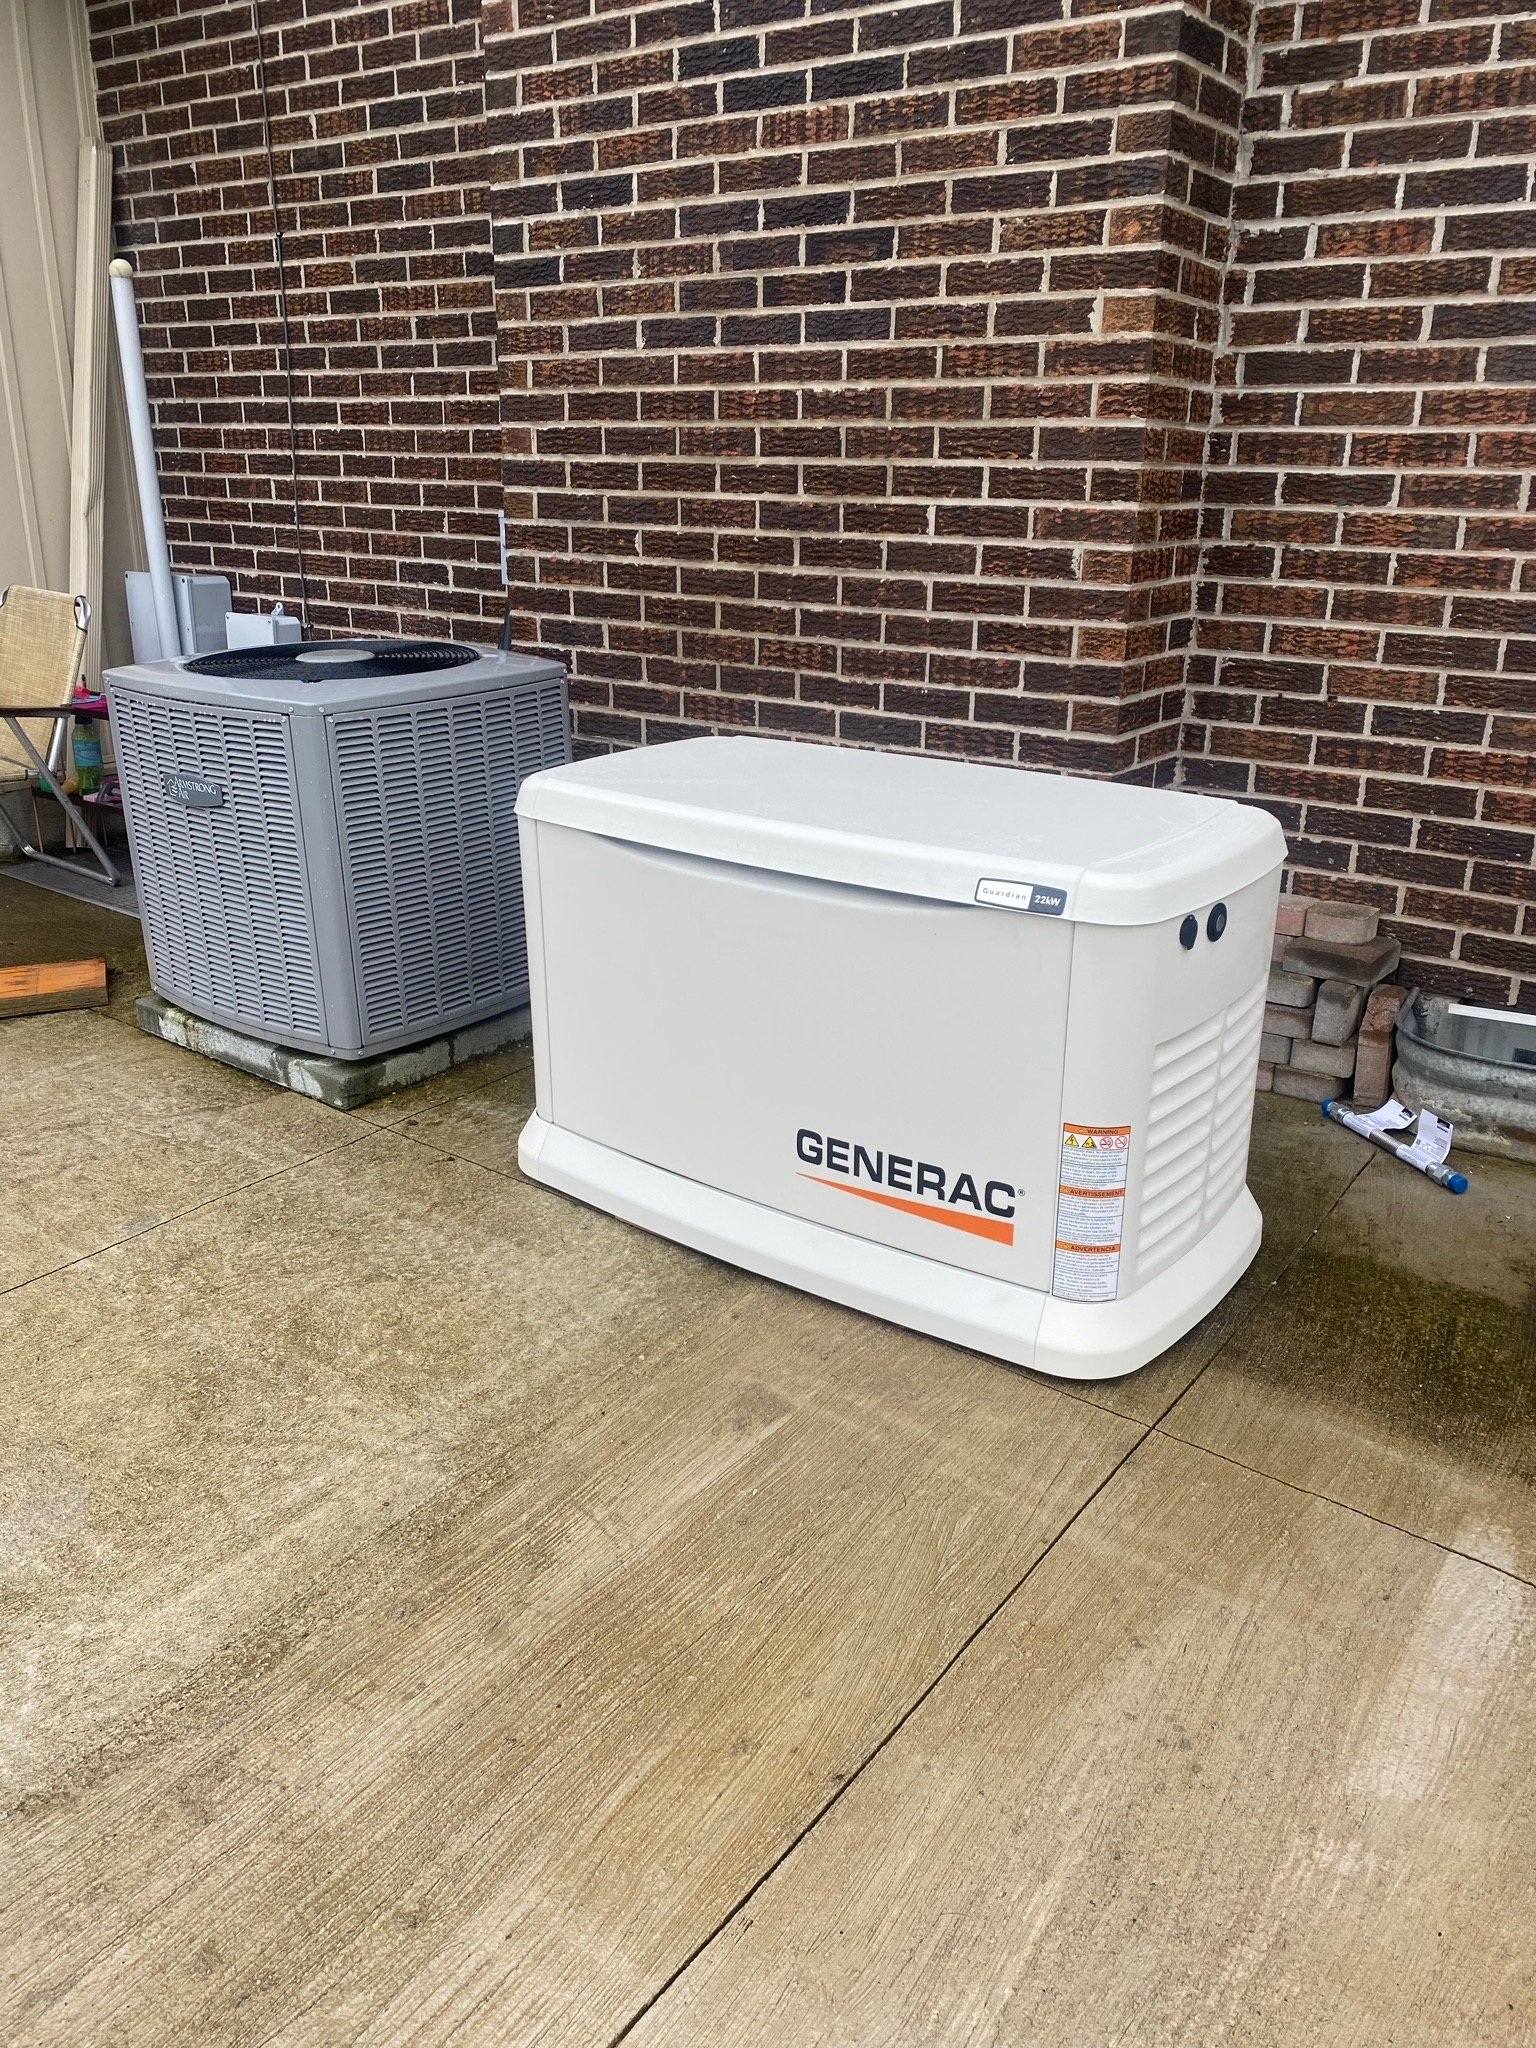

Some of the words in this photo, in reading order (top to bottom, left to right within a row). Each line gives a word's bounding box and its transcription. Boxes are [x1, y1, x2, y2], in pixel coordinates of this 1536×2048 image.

[174, 776, 217, 795] ARMSTRONG
[982, 887, 1027, 901] Guardian
[1034, 894, 1062, 907] 22kW
[796, 1128, 1016, 1218] GENERAC
[1069, 1189, 1123, 1197] AVERTISSEMENT
[1070, 1245, 1116, 1253] ADVERTENCIA
